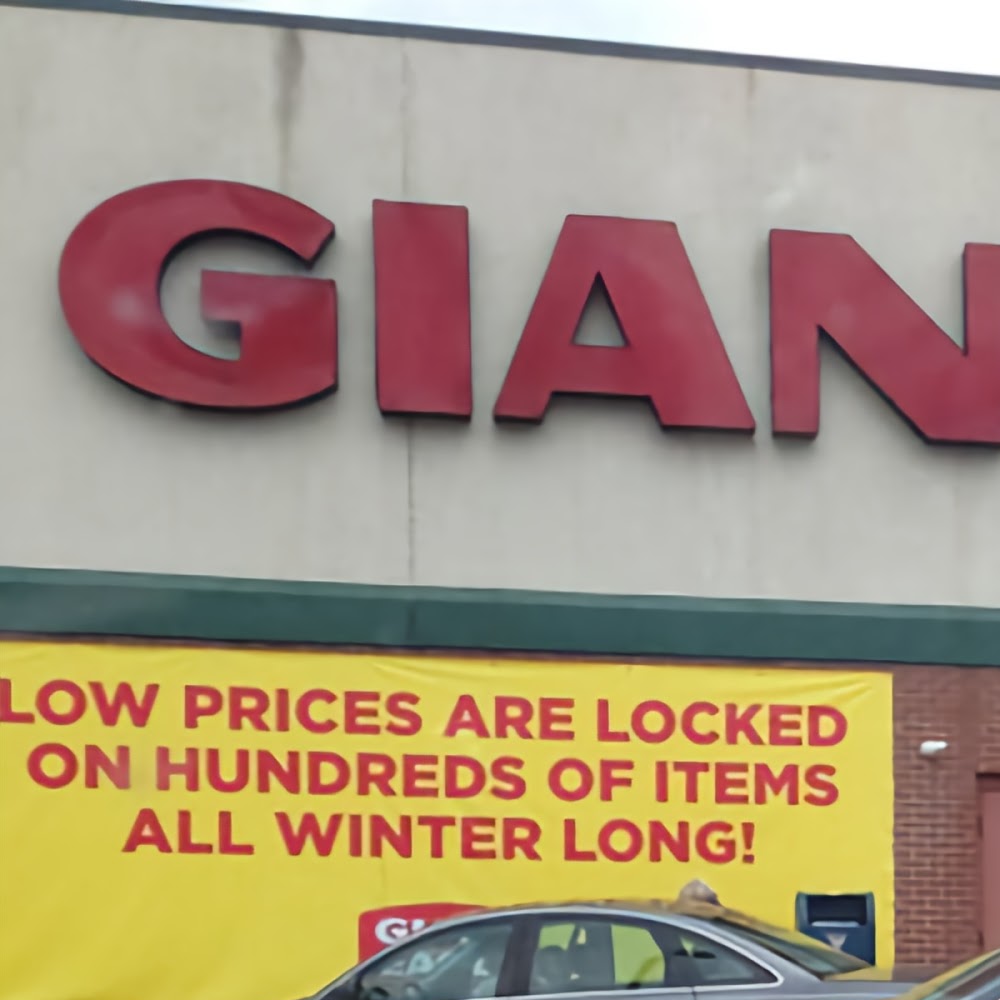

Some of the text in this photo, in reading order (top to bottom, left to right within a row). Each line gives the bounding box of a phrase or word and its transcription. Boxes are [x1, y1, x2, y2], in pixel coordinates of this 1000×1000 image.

[0, 678, 848, 747] LOW PRICES ARE LOCKED
[27, 743, 839, 806] ON HUNDREDS OF ITEMS
[122, 808, 756, 864] ALL WINTER LONG!
